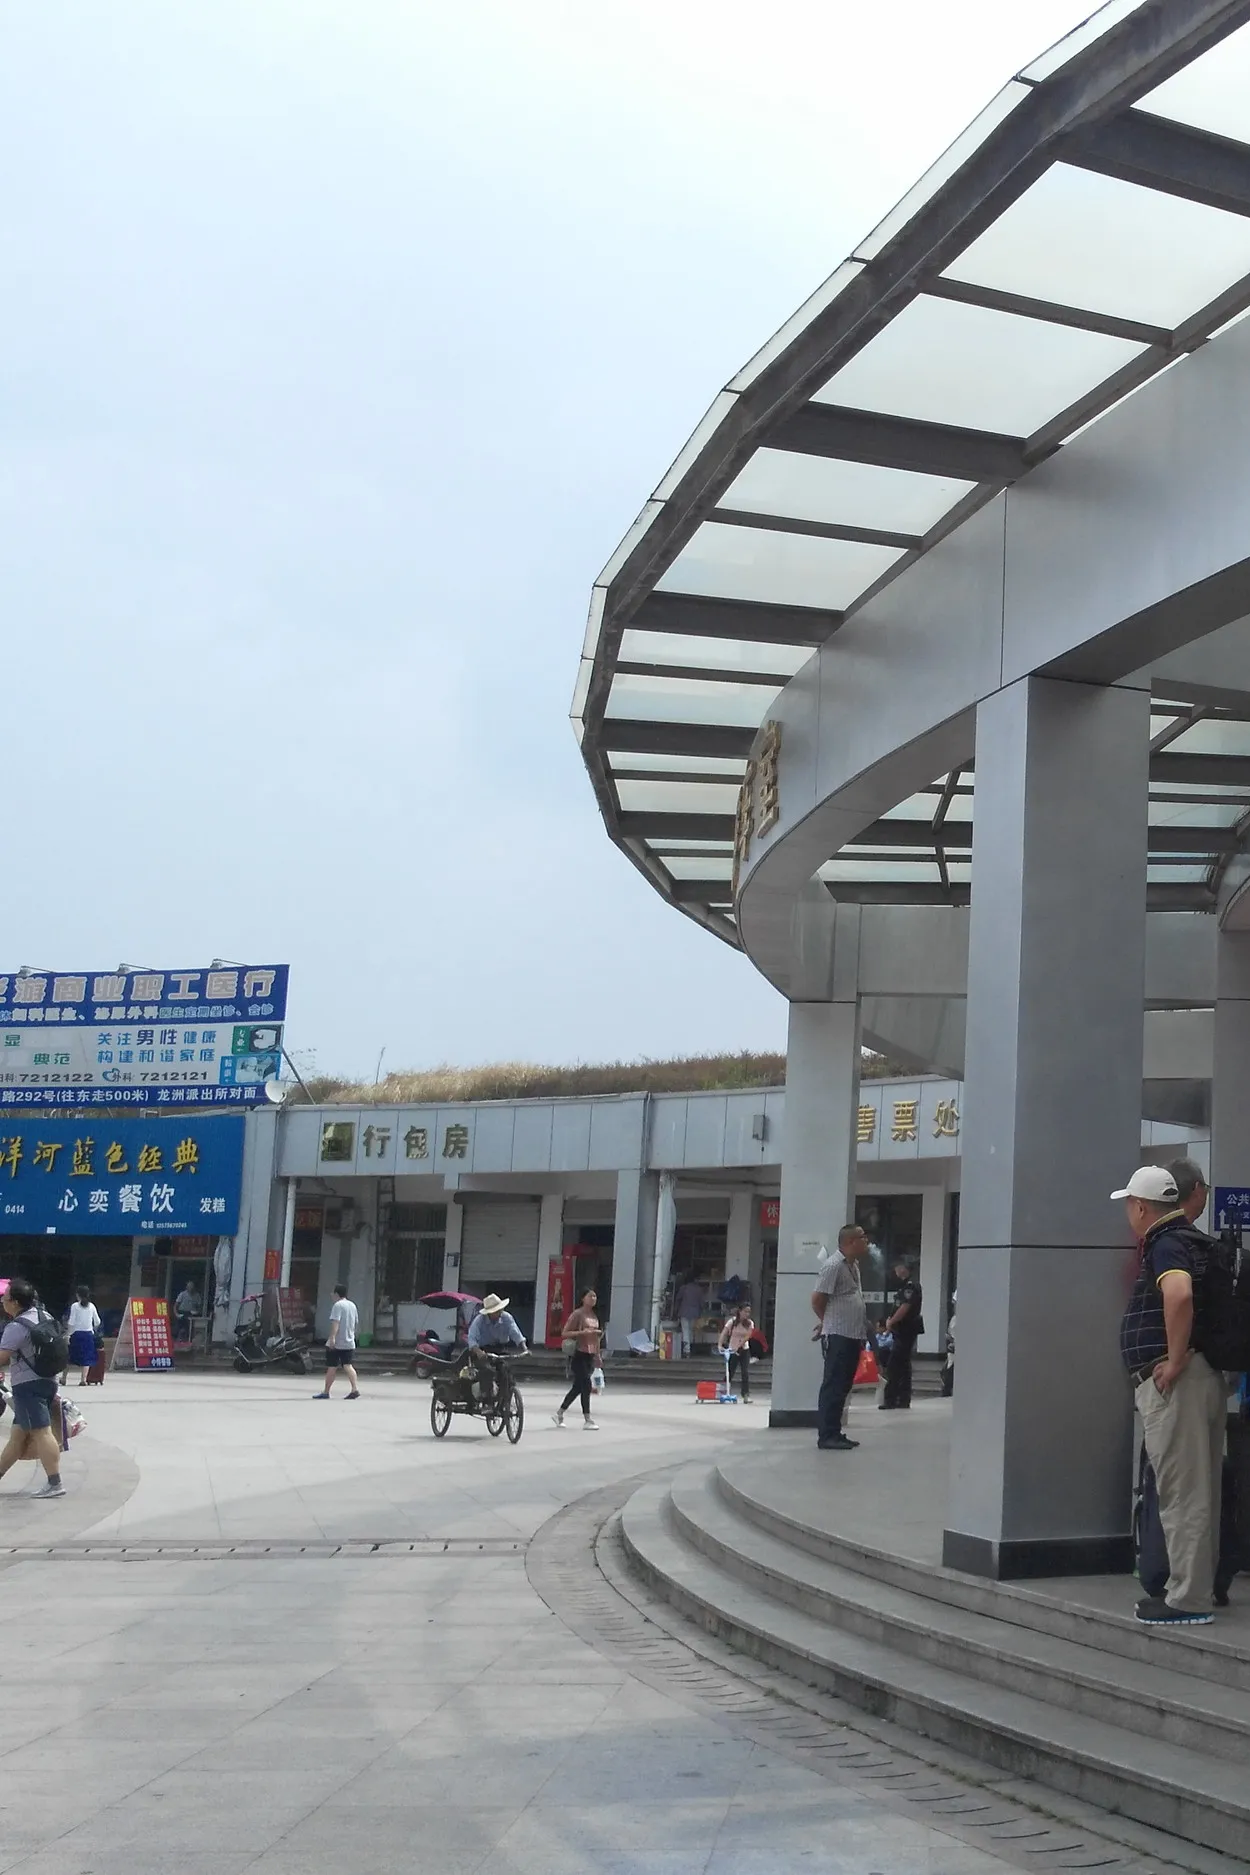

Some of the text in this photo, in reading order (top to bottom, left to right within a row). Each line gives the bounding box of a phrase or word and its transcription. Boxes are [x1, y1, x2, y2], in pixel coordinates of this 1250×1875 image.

[0, 970, 276, 1003] 游商业职工医疗
[97, 1029, 216, 1046] 关注男性健康
[33, 1053, 71, 1065] 典范
[97, 1048, 215, 1063] 构建和谐家庭
[19, 1073, 93, 1083] 7212122
[140, 1071, 208, 1081] 7212121
[157, 1086, 257, 1101] 龙洲派出所对面
[363, 1124, 468, 1158] 行包房
[58, 1183, 175, 1213] 心奕餐饮
[199, 1197, 226, 1213] 发糕
[5, 1204, 25, 1214] 0414
